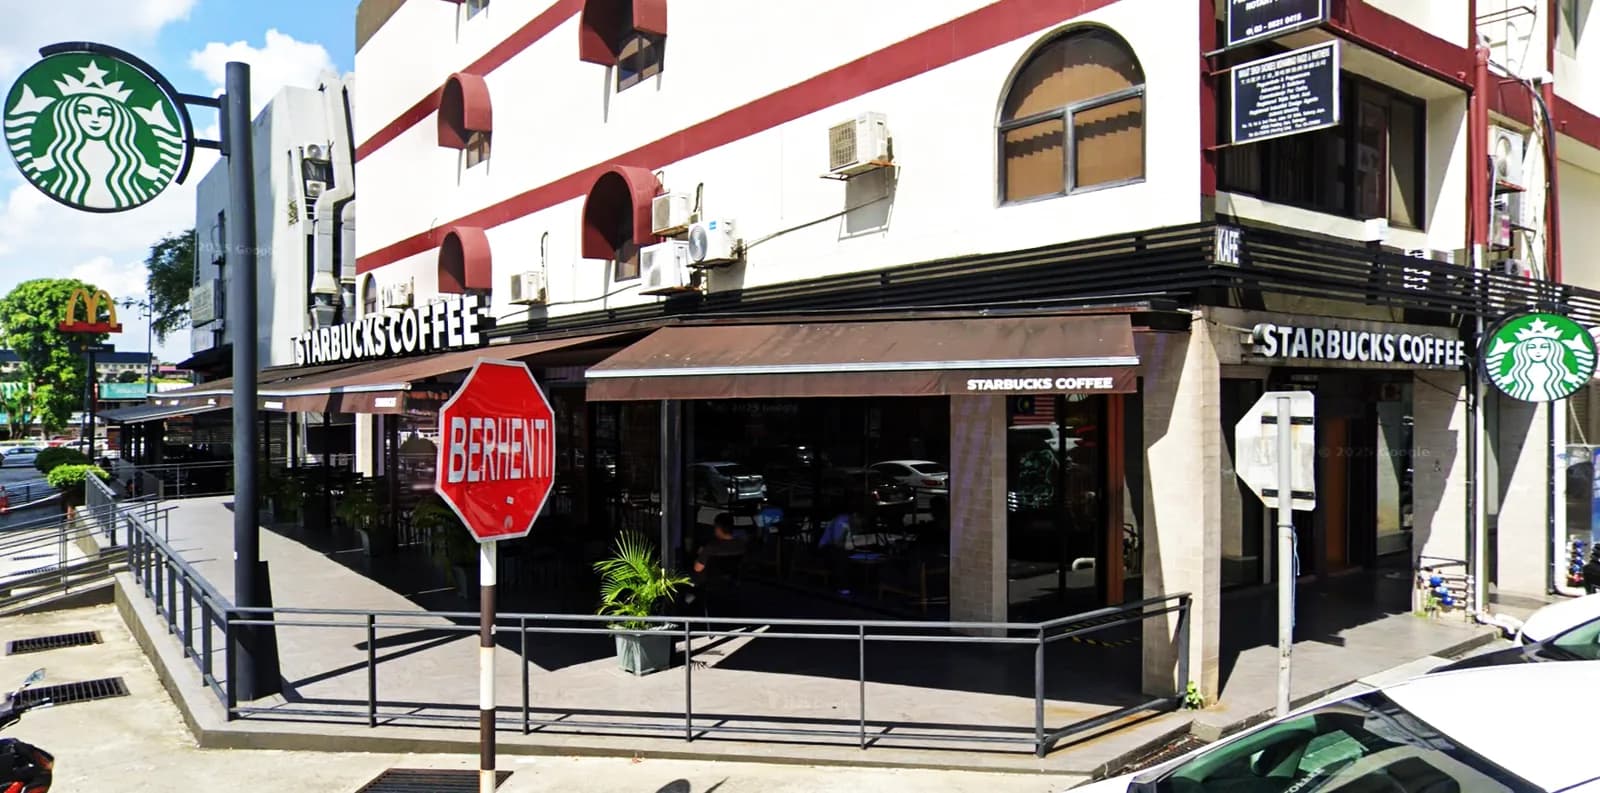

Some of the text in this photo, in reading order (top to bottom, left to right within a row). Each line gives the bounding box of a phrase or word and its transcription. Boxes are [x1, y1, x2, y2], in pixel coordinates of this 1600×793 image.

[1216, 228, 1240, 265] KAFE
[294, 295, 480, 366] STARBUCKS COFFEE
[1261, 323, 1466, 366] STARBUCKS COFFEE
[966, 377, 1114, 391] STARBUCKS COFFEE
[447, 416, 550, 484] BERHENTI
